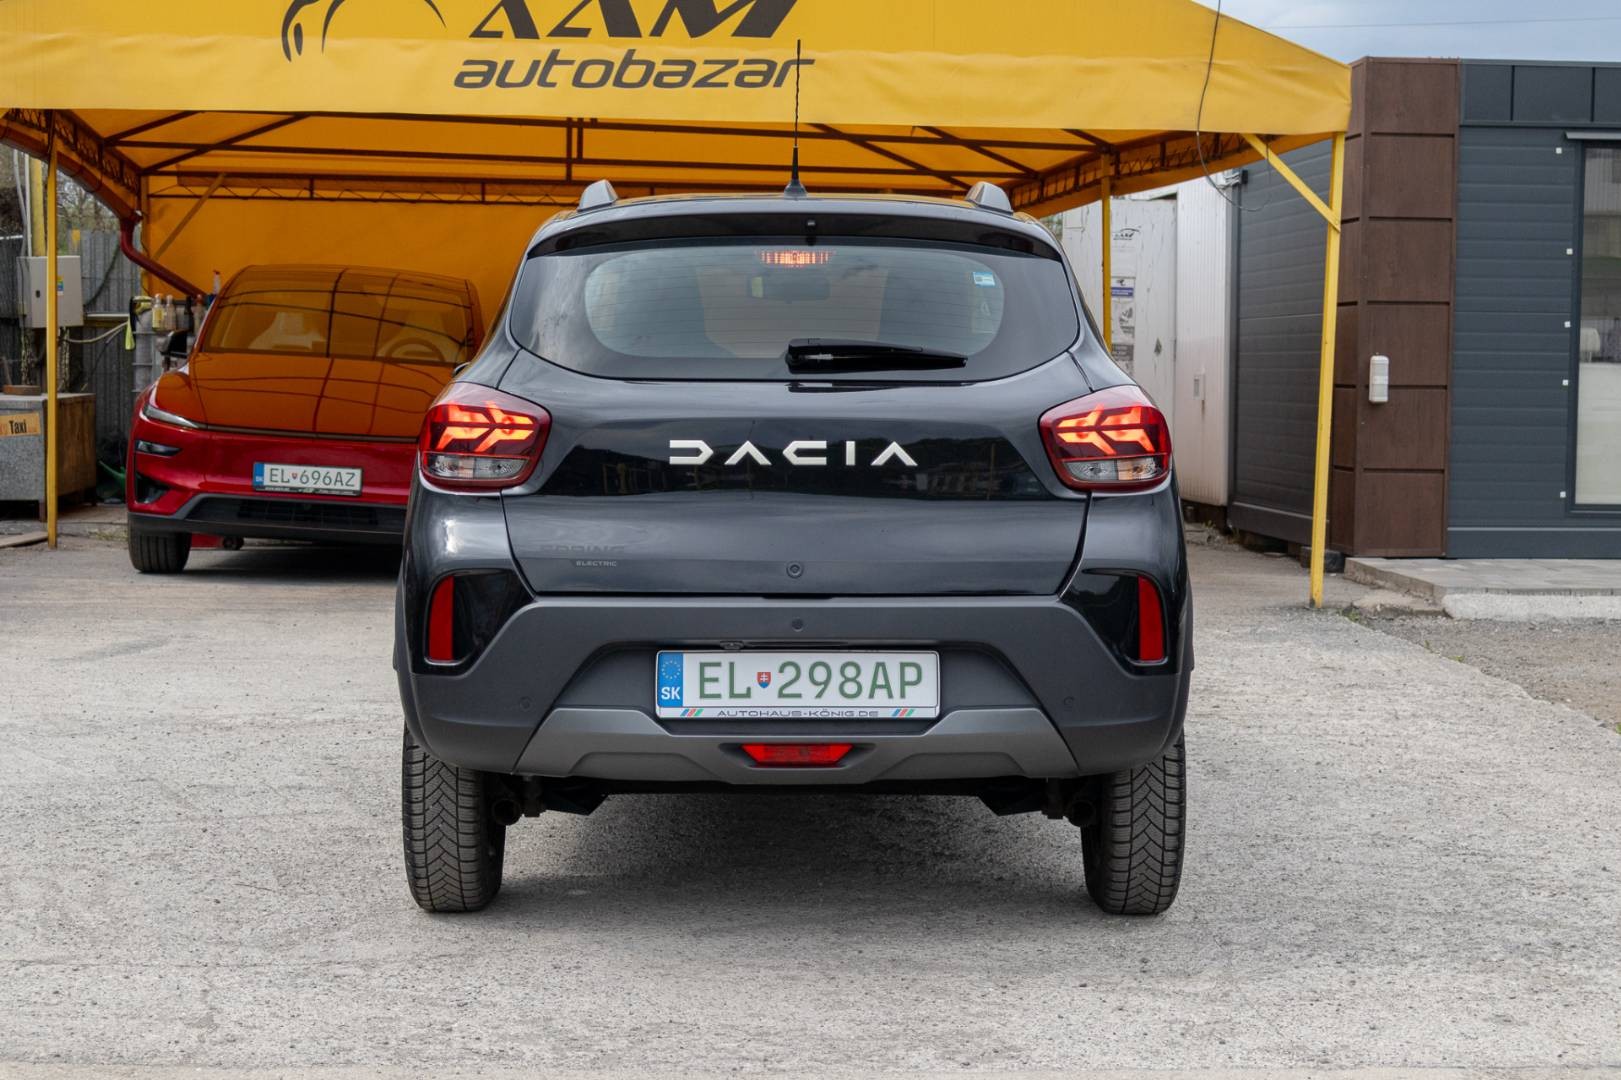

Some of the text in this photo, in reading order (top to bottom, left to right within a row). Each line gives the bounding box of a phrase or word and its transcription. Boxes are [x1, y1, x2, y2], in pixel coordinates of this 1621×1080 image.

[454, 48, 815, 89] autobazar
[9, 419, 27, 434] Taxi
[669, 440, 918, 465] DACIA
[269, 468, 356, 487] EL 696AZ
[699, 661, 923, 699] EL 298AP
[661, 686, 681, 700] SK
